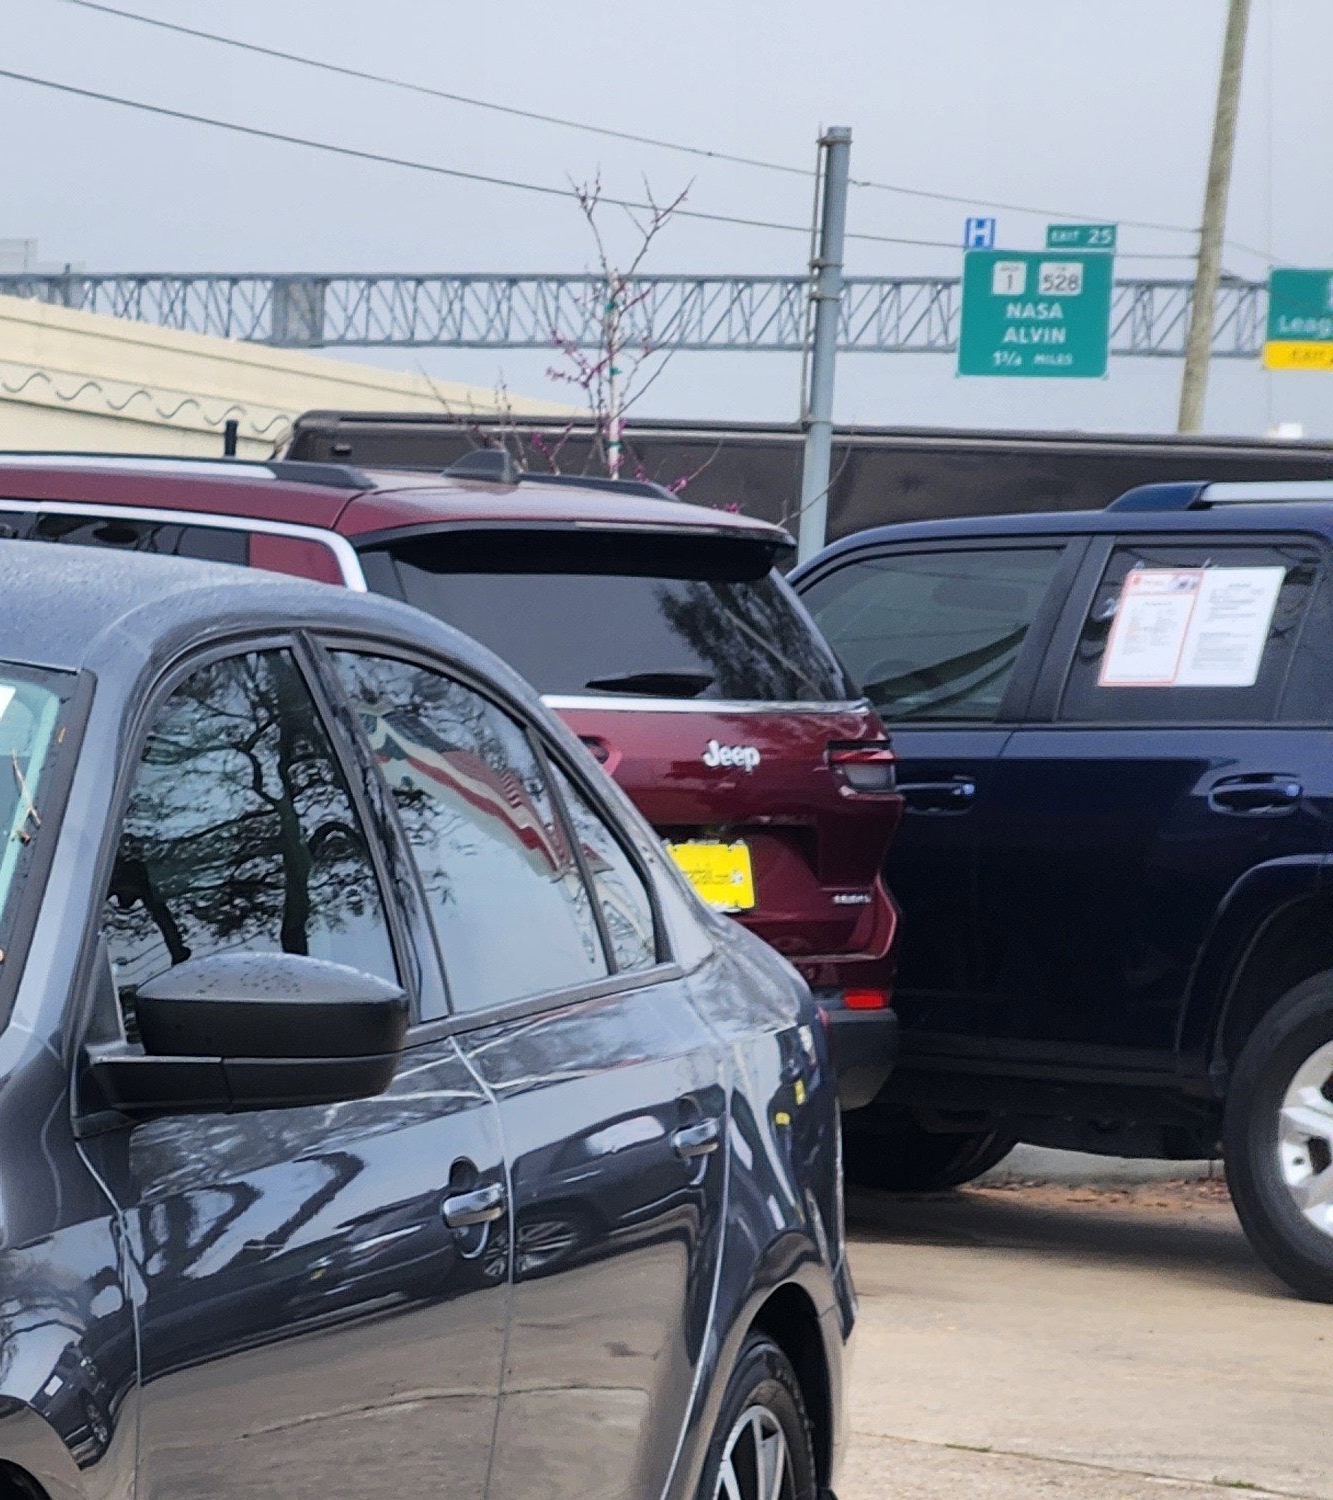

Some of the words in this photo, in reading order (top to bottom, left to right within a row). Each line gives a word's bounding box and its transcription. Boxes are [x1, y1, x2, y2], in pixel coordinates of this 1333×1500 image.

[1087, 229, 1112, 244] 25
[1042, 273, 1079, 292] 528
[1004, 302, 1064, 320] NASA
[1002, 326, 1066, 345] ALVIN
[701, 738, 762, 774] Jeep
